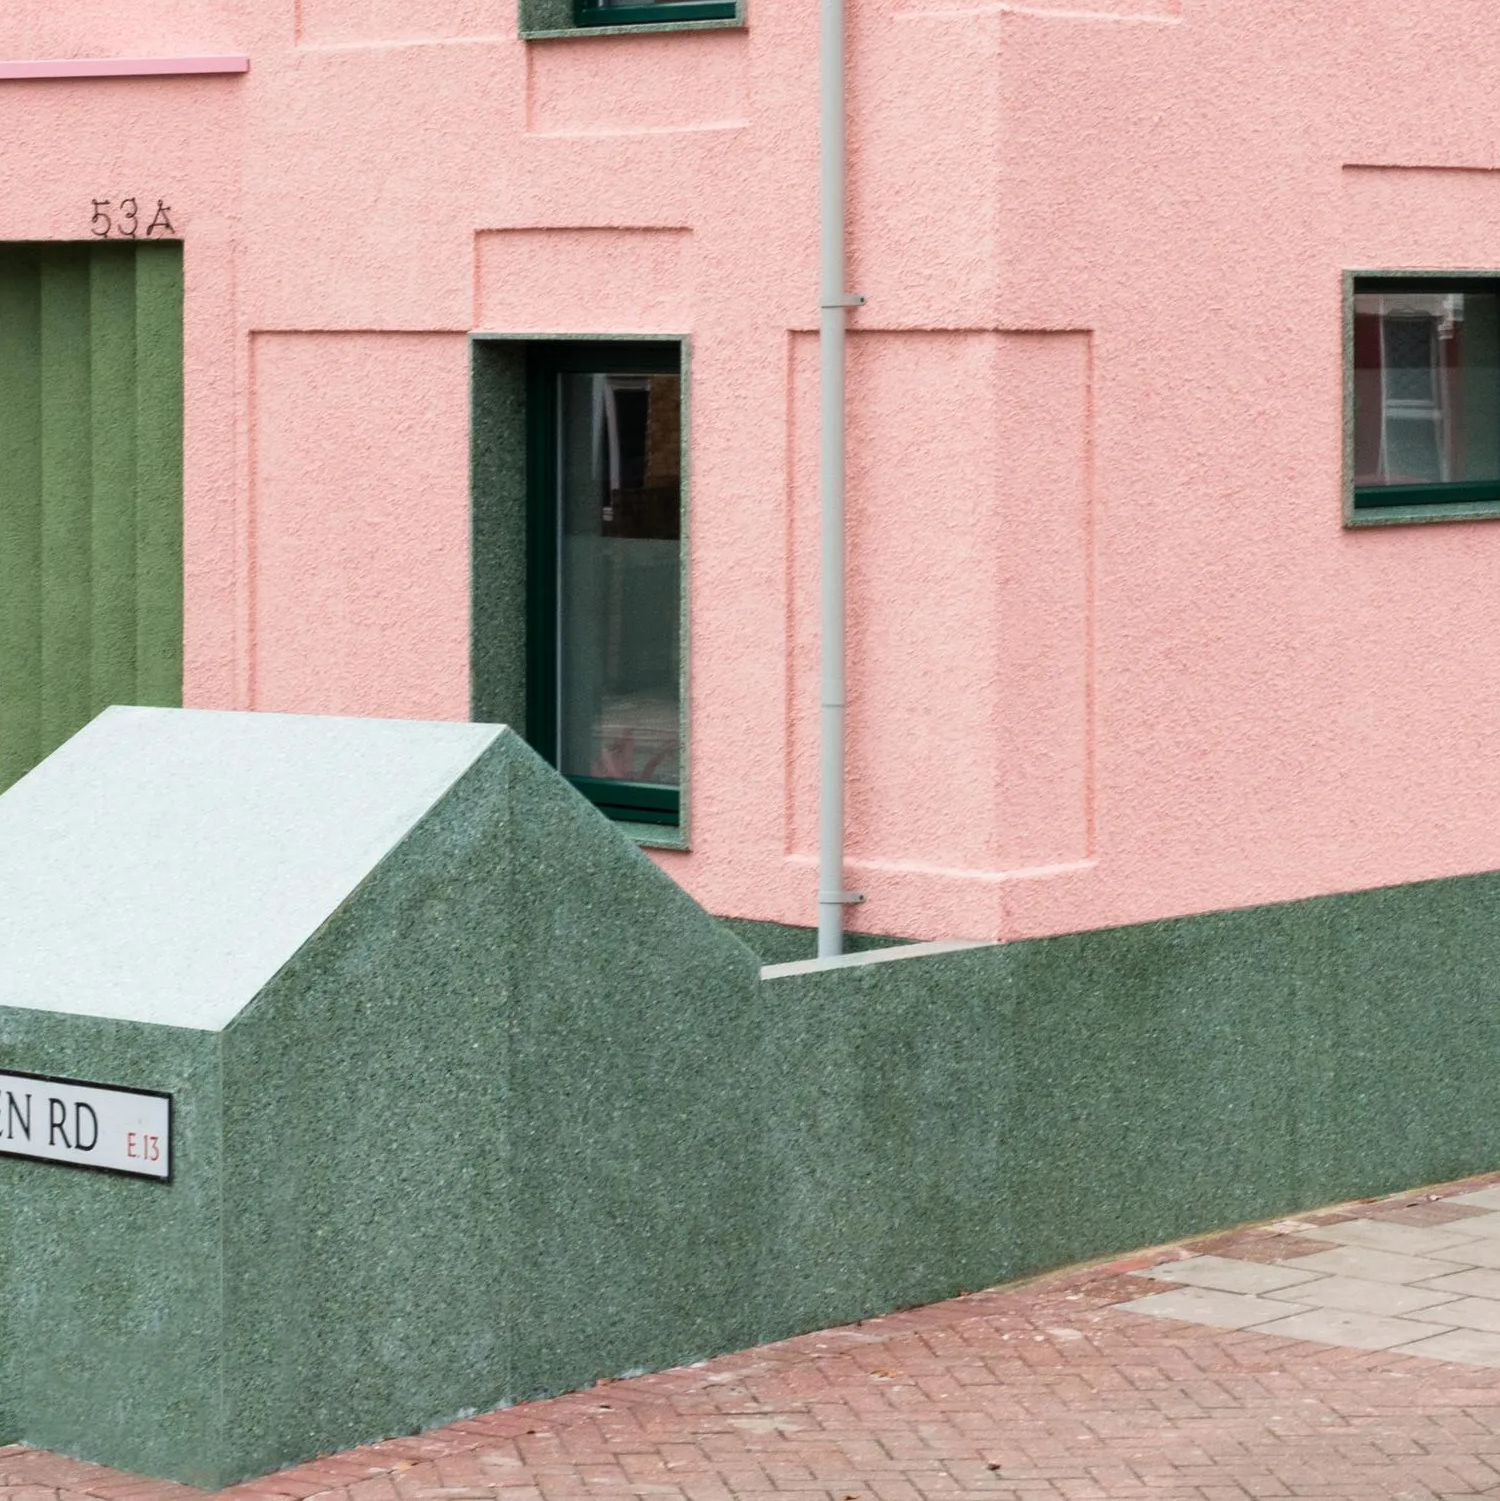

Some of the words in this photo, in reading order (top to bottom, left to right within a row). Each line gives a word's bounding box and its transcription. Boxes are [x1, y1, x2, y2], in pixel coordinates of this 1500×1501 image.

[91, 197, 176, 238] 53A
[48, 1098, 98, 1151] RD
[127, 1132, 160, 1161] E.13
